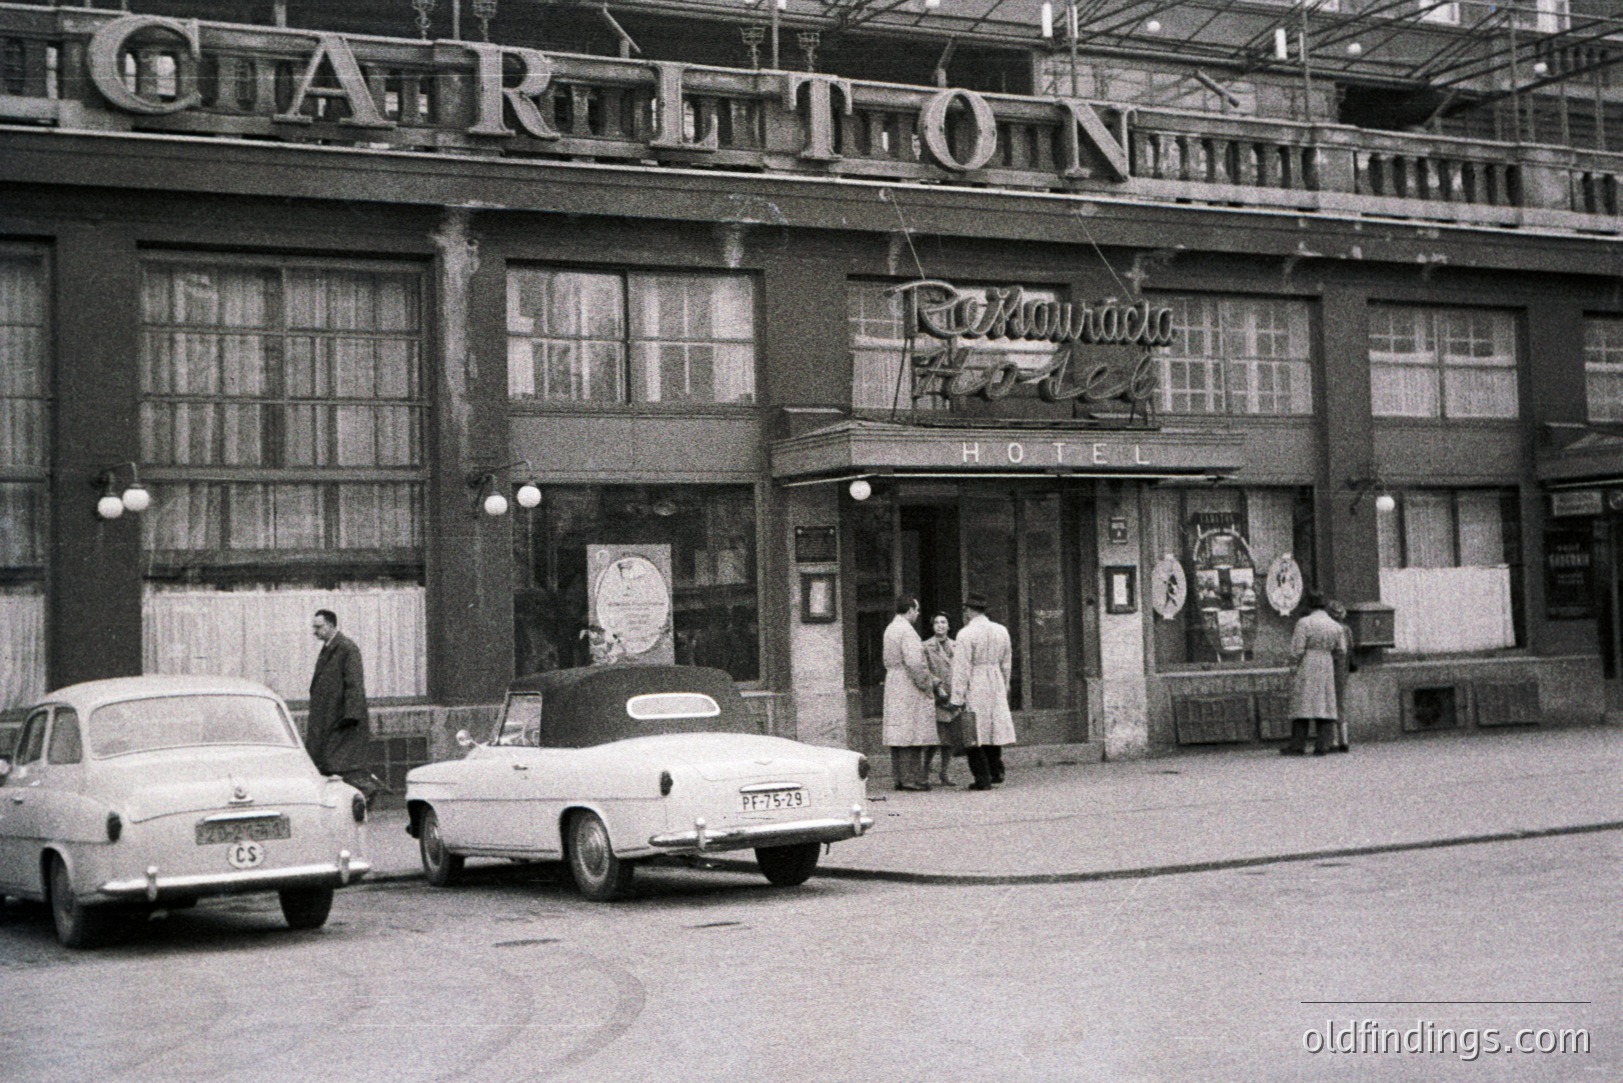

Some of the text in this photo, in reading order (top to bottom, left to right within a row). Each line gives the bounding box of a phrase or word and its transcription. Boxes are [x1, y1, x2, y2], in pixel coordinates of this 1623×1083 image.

[88, 15, 1136, 183] CARLTON
[962, 441, 1150, 465] HOTEL
[742, 792, 803, 810] PF-75-29
[236, 846, 257, 862] CS
